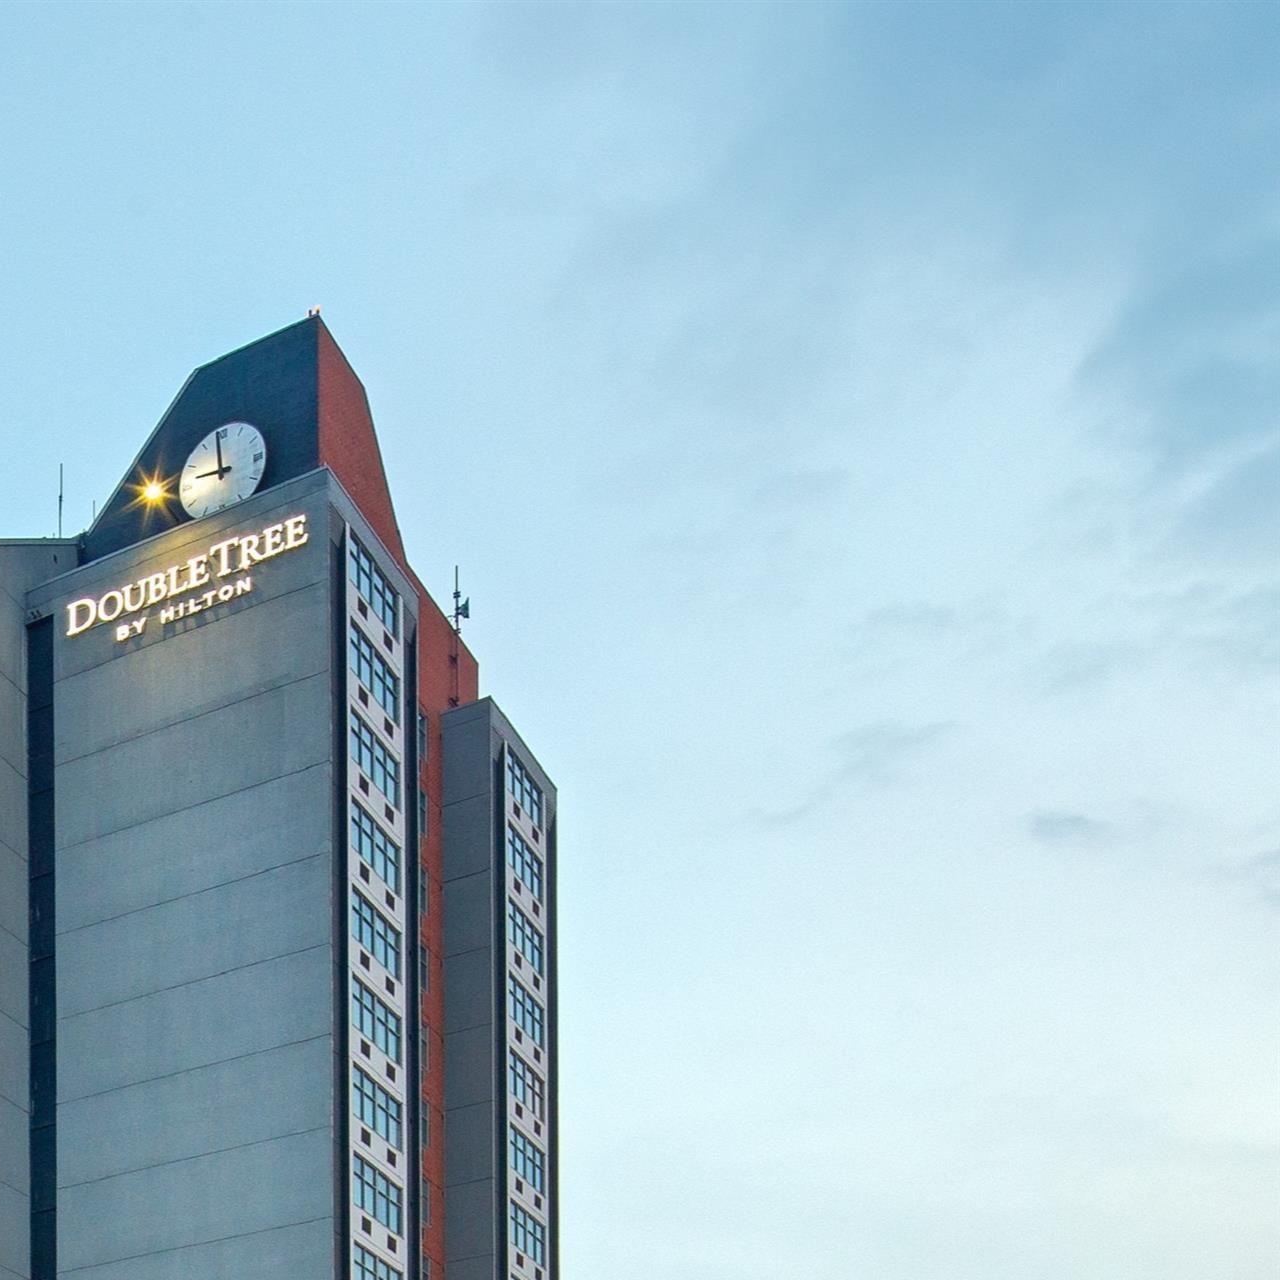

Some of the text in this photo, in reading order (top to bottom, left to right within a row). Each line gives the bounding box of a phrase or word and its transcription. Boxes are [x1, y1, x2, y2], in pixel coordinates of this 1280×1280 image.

[66, 514, 308, 636] DOUBLETREE
[116, 577, 251, 641] BY HILTON
